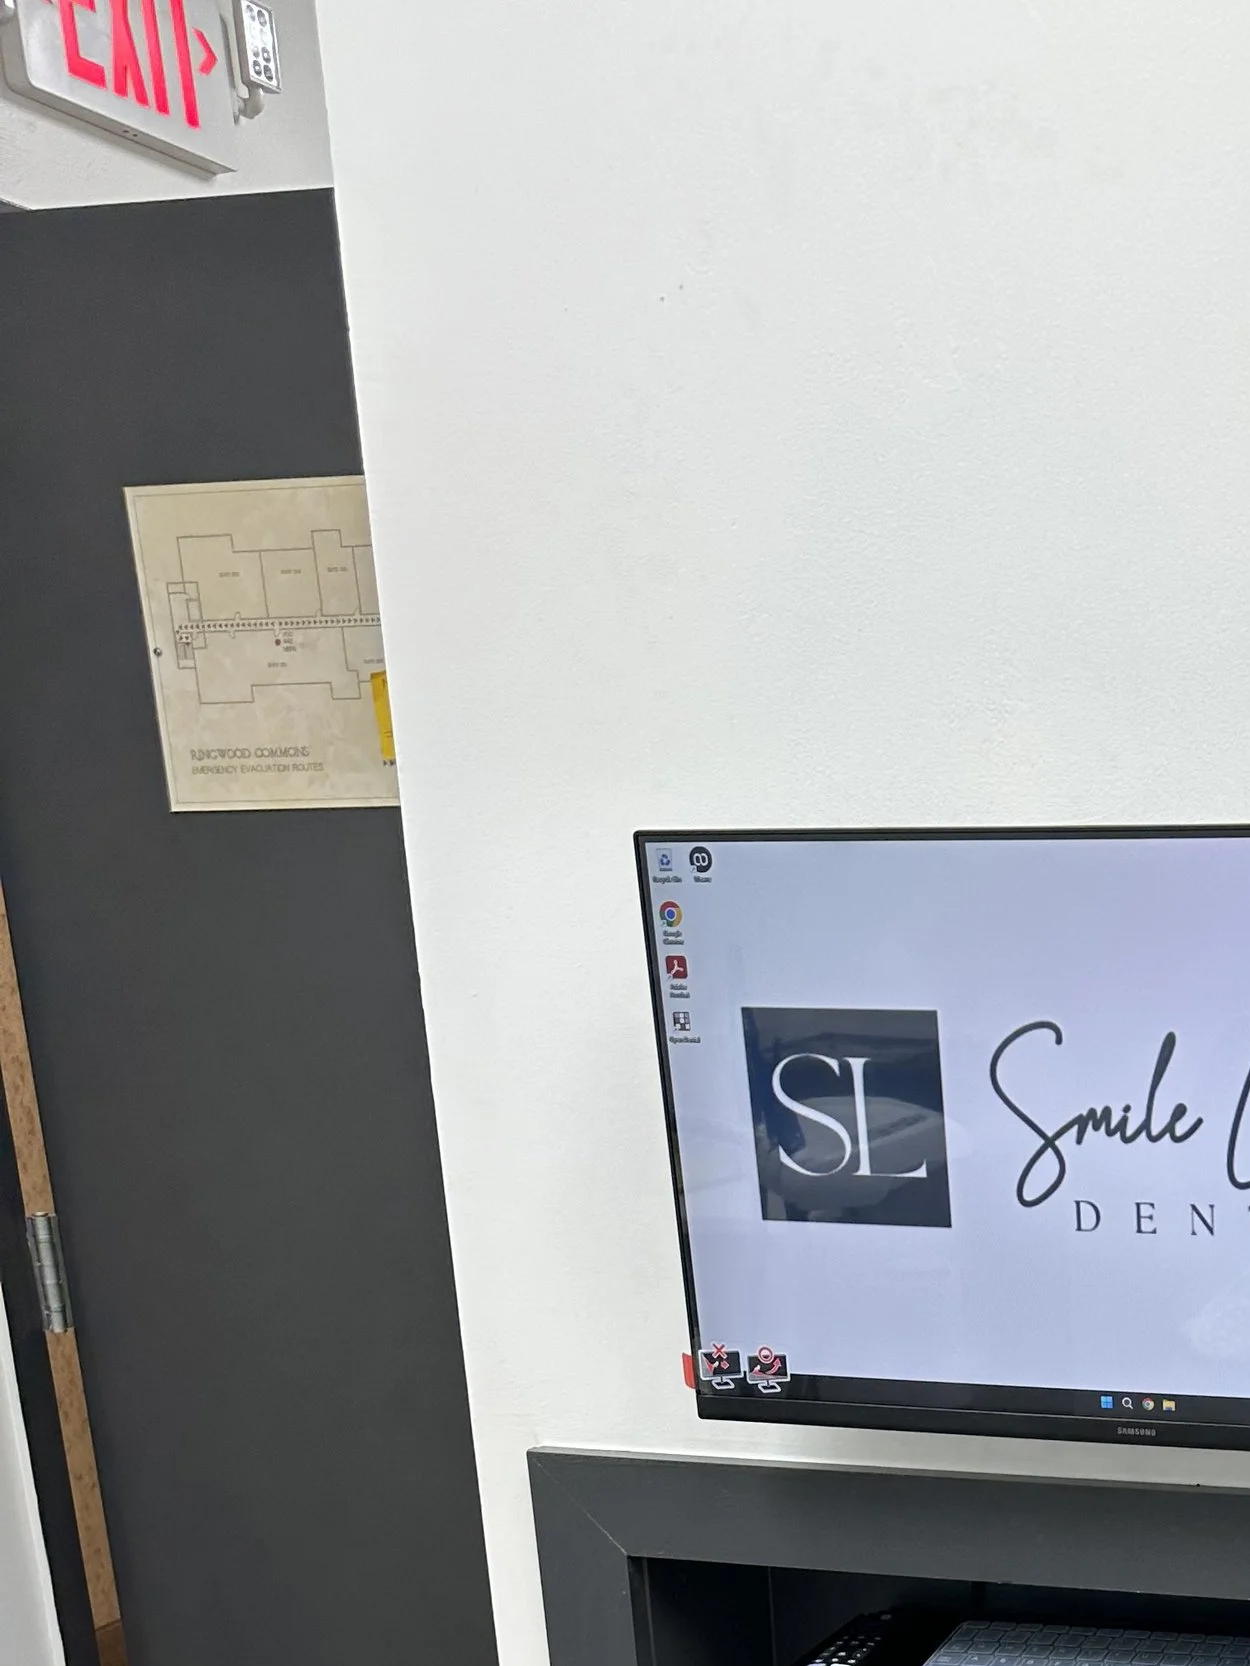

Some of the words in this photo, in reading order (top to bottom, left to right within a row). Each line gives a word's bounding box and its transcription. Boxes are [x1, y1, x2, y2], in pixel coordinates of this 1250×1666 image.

[771, 1053, 928, 1178] SL
[990, 1020, 1204, 1208] Smile
[1117, 1427, 1156, 1436] SAMSUNG
